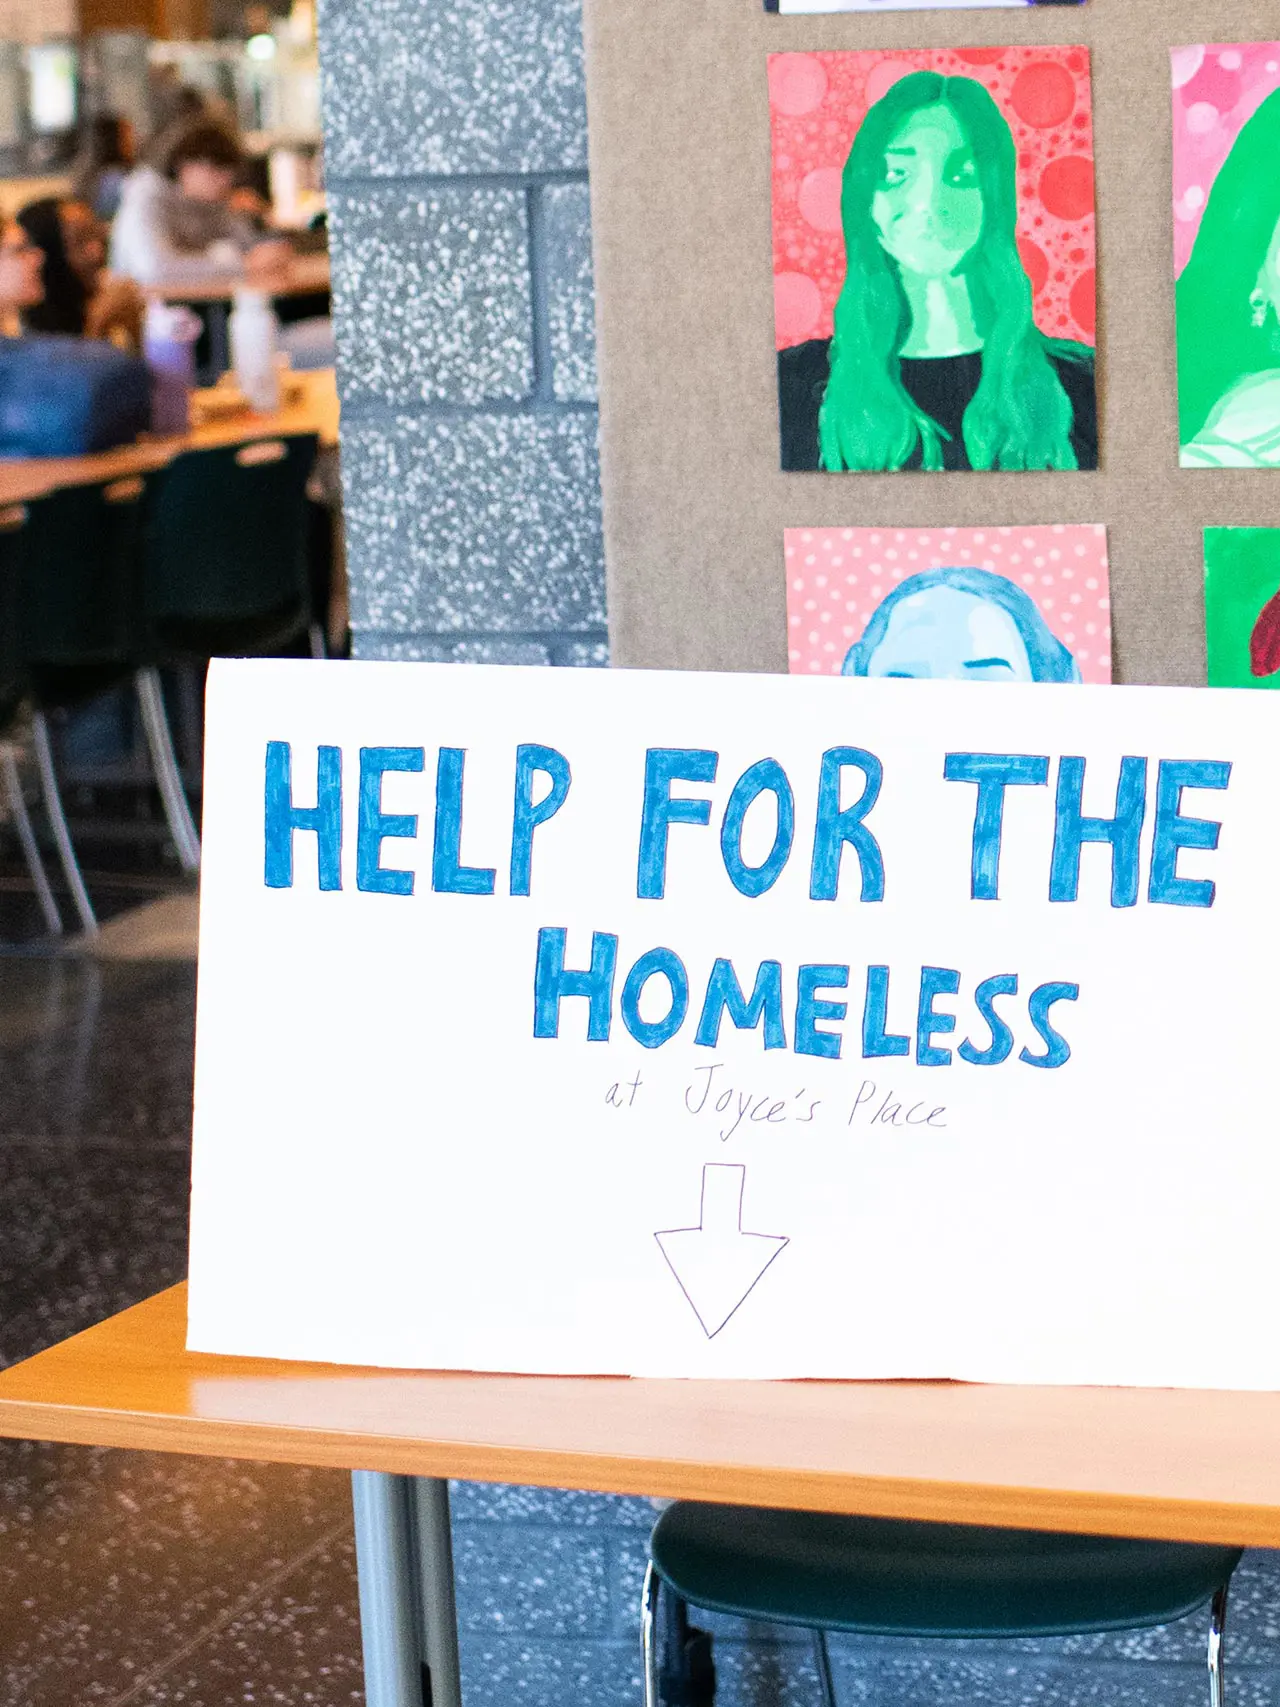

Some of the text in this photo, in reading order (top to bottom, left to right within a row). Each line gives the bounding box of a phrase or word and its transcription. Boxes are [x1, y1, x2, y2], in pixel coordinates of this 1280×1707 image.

[264, 740, 1233, 908] HELP FOR THE
[533, 927, 1079, 1068] HOMELESS
[606, 1064, 947, 1141] at Joyce's Place
